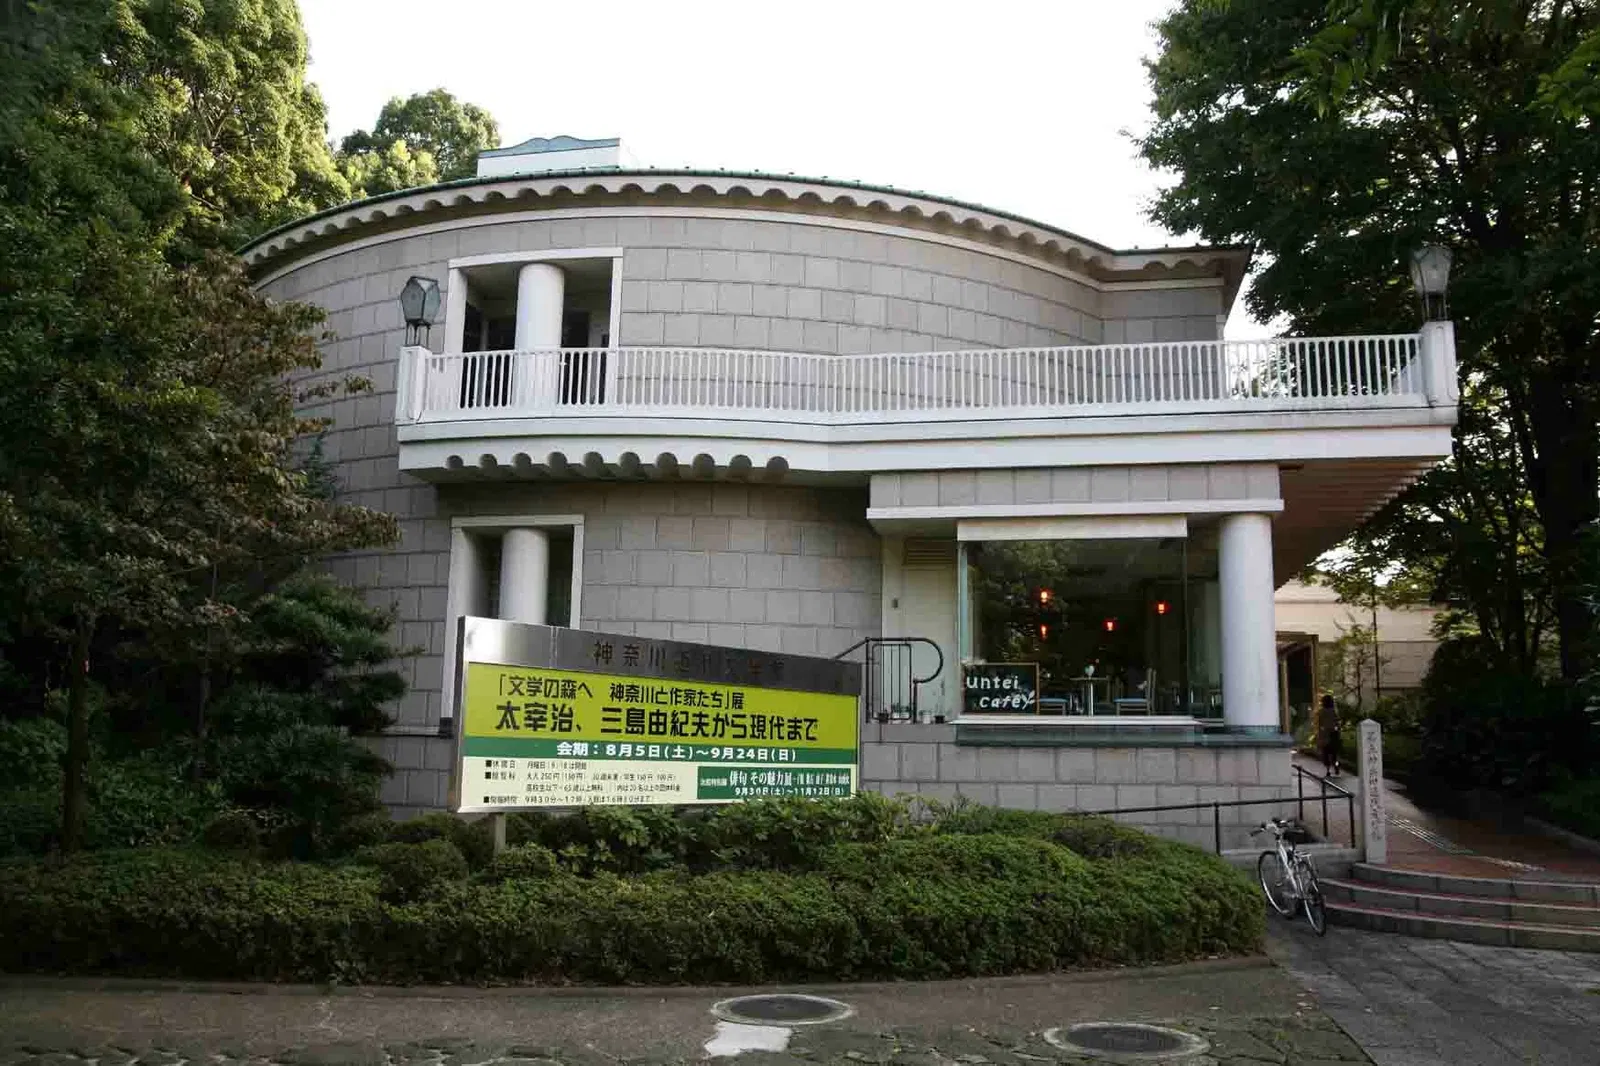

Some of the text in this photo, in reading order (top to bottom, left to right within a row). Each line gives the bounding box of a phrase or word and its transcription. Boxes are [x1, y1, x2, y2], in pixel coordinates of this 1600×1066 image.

[499, 675, 745, 709] 「文学の森へ 神奈川と作家たち」展
[966, 676, 1019, 690] untei
